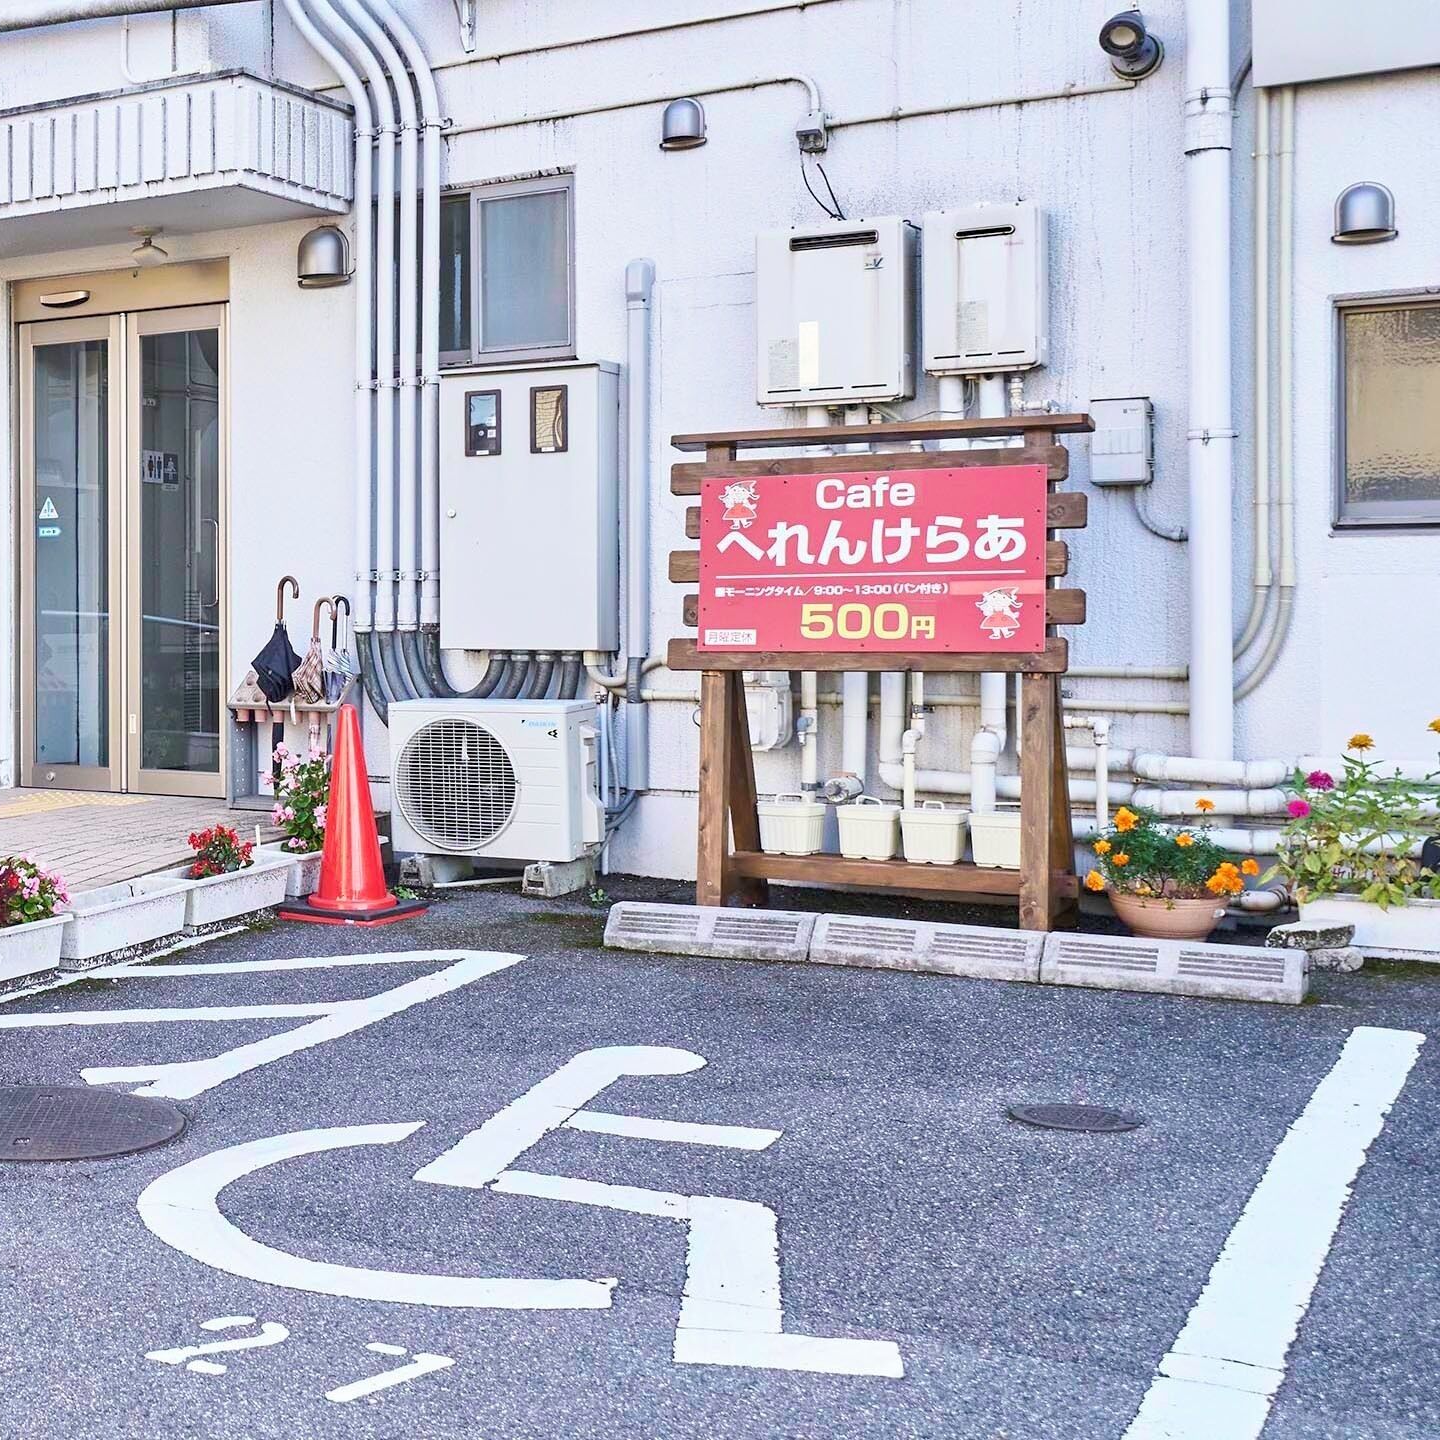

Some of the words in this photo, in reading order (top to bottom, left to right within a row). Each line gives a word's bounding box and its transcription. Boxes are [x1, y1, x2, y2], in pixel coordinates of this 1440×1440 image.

[815, 476, 916, 510] Cafe
[716, 514, 1027, 567] へれんけらあ
[800, 603, 935, 640] 500円
